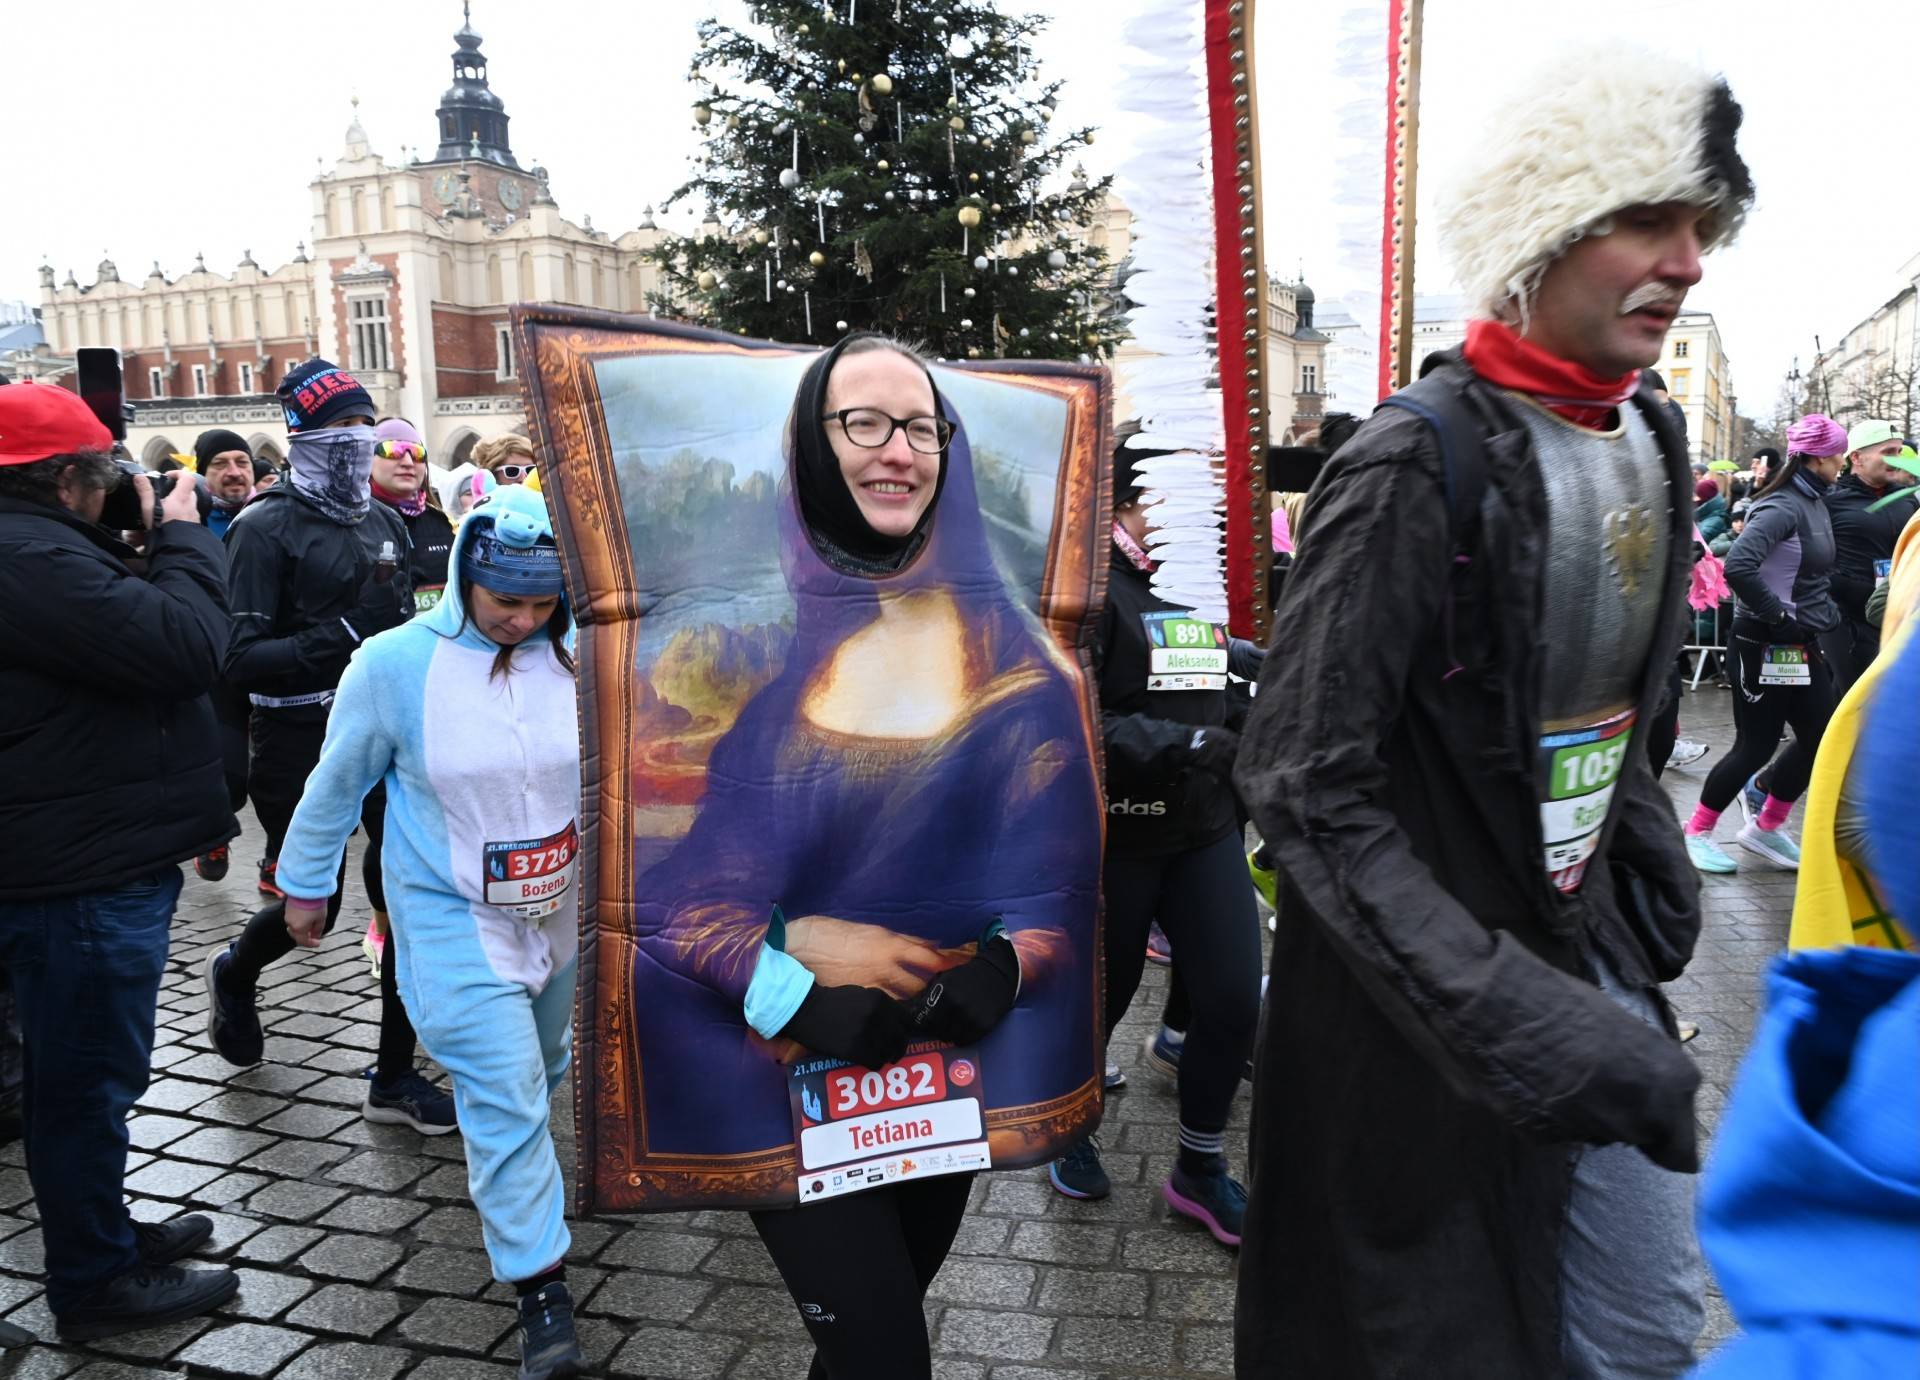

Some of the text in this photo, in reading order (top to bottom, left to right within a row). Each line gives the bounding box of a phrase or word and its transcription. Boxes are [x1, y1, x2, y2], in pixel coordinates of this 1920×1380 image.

[296, 371, 354, 410] BIEG
[1175, 623, 1208, 645] 891
[1167, 654, 1220, 669] Aleksandra
[1780, 651, 1798, 663] 175
[514, 842, 569, 876] 3726
[522, 875, 565, 897] Bożena
[836, 1062, 936, 1112] 3082
[848, 1119, 933, 1151] Tetiana
